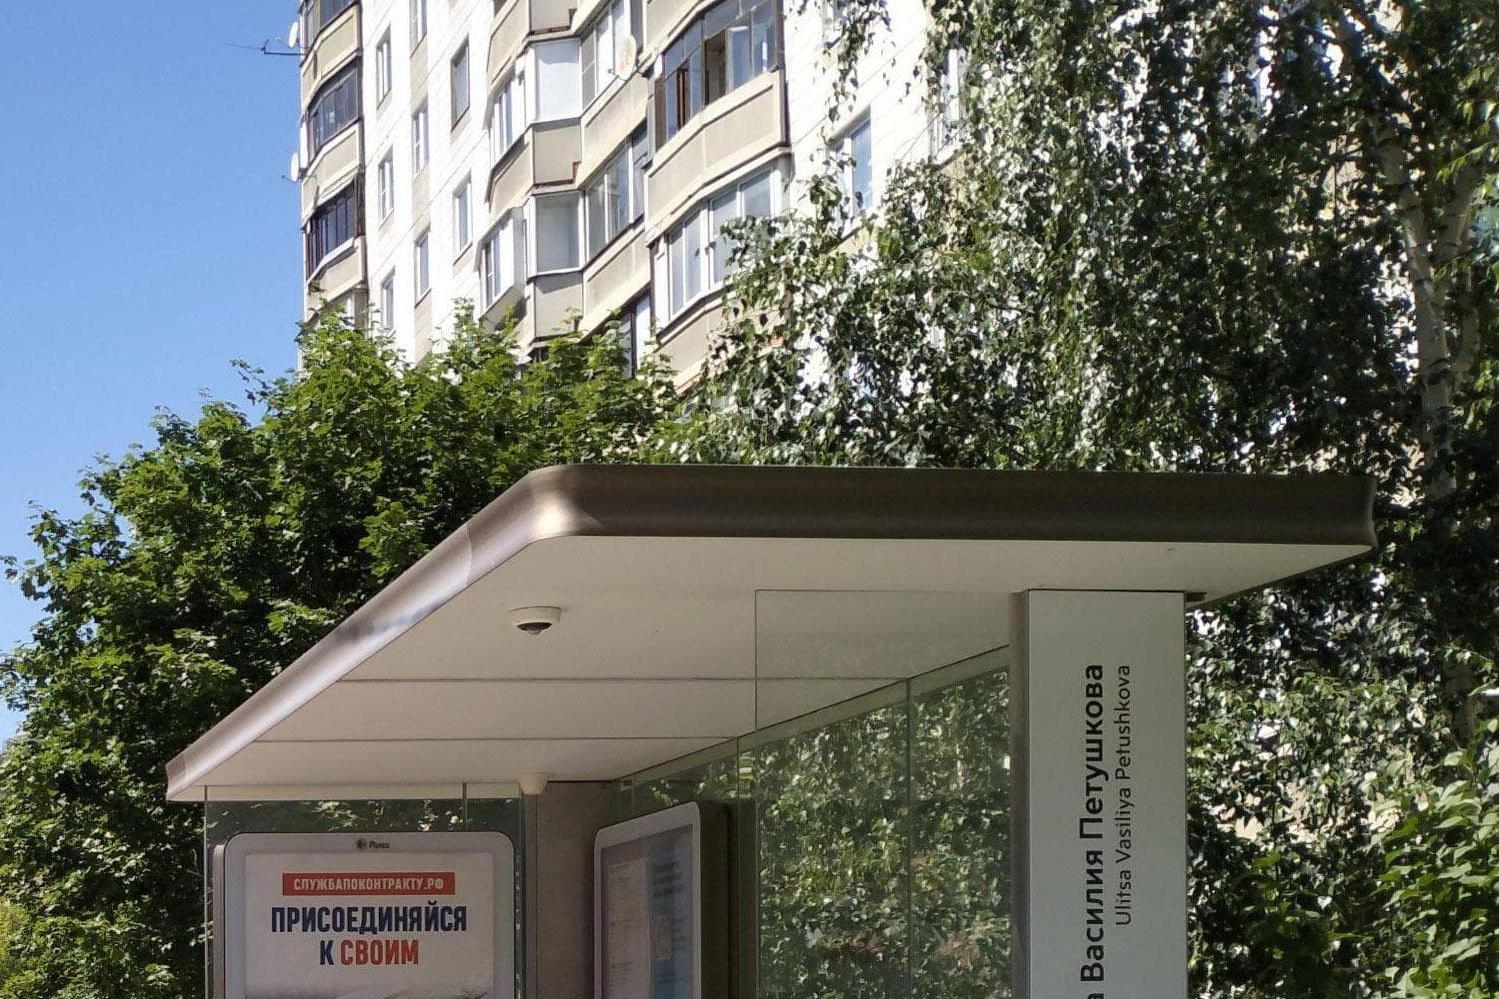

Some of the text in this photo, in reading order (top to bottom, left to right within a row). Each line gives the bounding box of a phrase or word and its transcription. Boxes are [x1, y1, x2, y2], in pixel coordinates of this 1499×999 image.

[1079, 664, 1109, 839] Петушкова
[1113, 665, 1134, 926] Ulitsa Vasiliya Petushkova
[271, 900, 467, 935] ПРИСОЕДИНЯЙСЯ
[293, 877, 444, 891] СЛУЖБАПОКОНТРАКТУ.РФ
[1080, 850, 1105, 982] Василия
[320, 939, 419, 966] К СВОИМ
